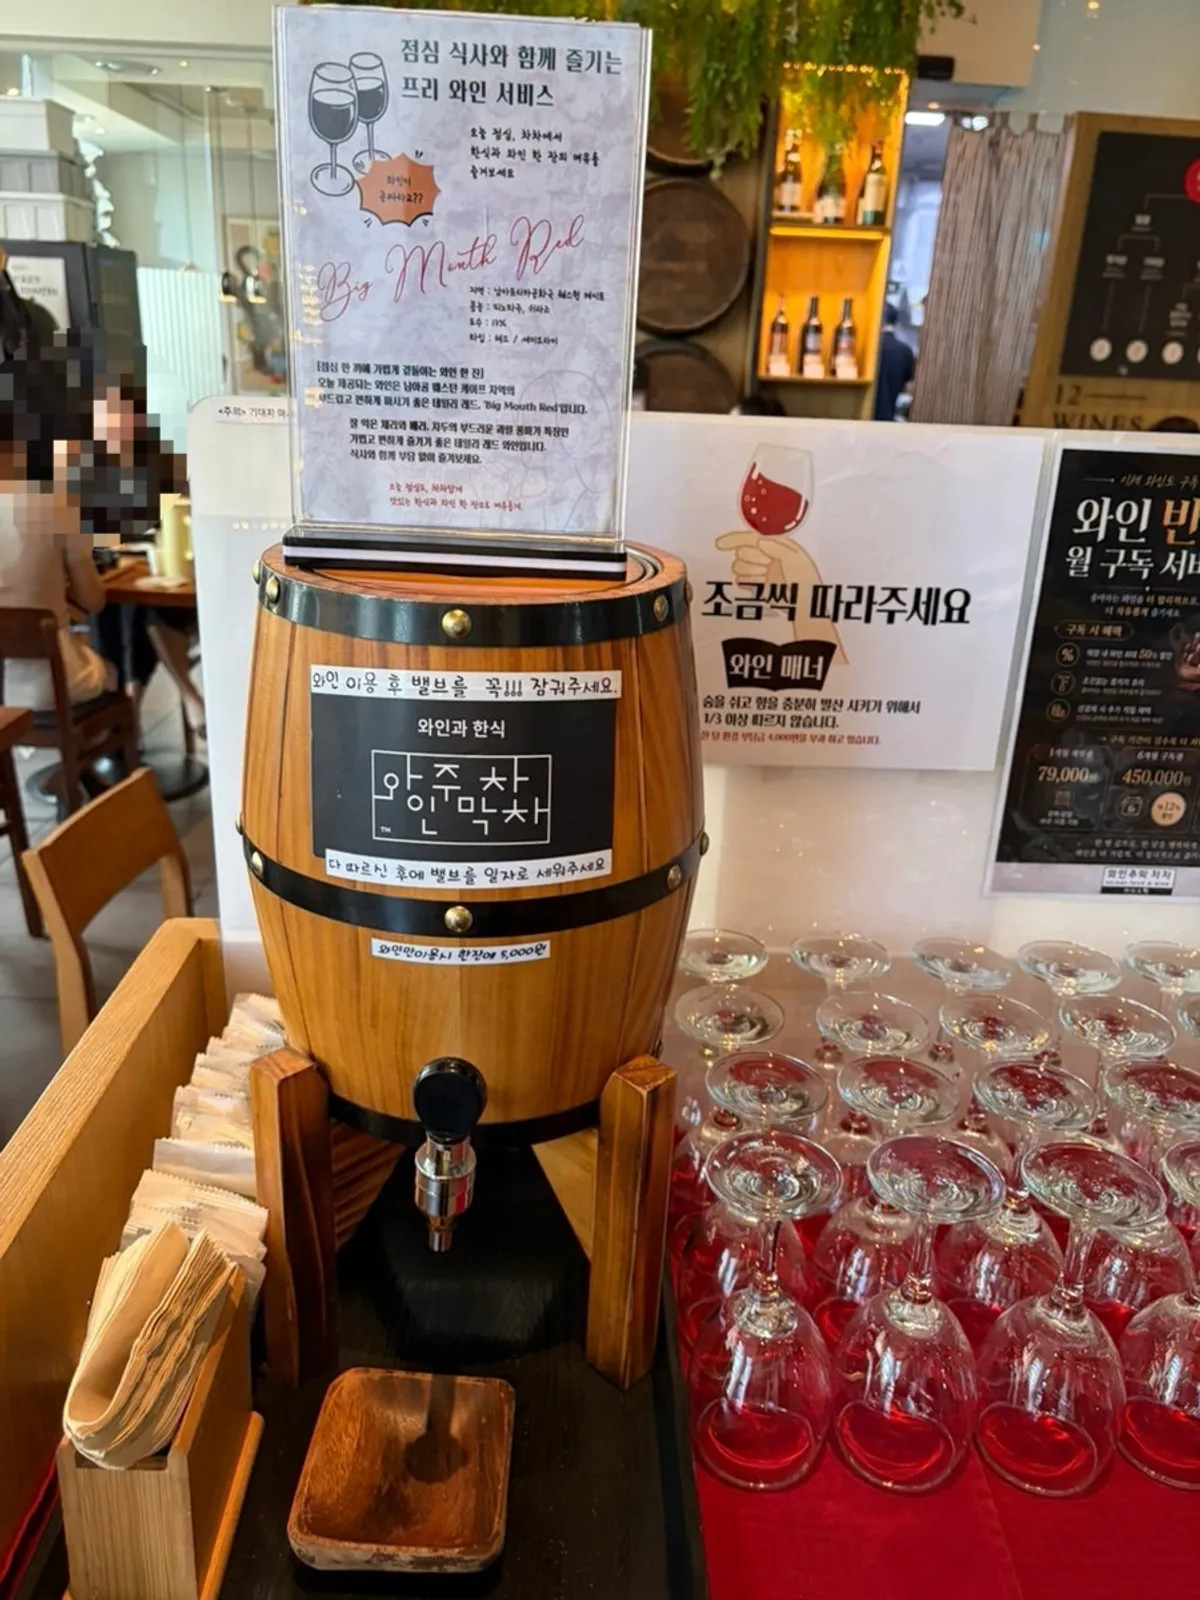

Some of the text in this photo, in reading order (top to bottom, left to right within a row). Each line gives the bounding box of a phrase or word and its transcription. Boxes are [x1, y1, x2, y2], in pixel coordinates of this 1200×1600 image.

[401, 39, 623, 75] 점심 식사와 함께 즐기는
[402, 77, 555, 107] 프리 와인 서비스
[470, 126, 487, 140] 오늘
[521, 129, 562, 143] 차차에서
[470, 144, 500, 159] 한식과
[507, 148, 526, 161] 와인
[532, 148, 541, 163] 한
[573, 151, 599, 167] 여유를
[317, 214, 585, 323] Big Mouth Red
[341, 362, 350, 374] 한
[373, 363, 400, 375] 가볍게
[439, 366, 457, 379] 와인
[459, 367, 469, 379] 한
[318, 377, 335, 388] 오늘
[337, 378, 372, 390] 제공되는
[374, 380, 401, 391] 와인은
[403, 381, 429, 393] 남아공
[461, 383, 486, 394] 케이프
[489, 385, 516, 396] 지역의
[1055, 383, 1083, 406] 12
[355, 394, 381, 406] 편하게
[384, 395, 410, 407] 마시기
[412, 397, 429, 409] 좋은
[432, 398, 458, 409] 데일리
[503, 401, 537, 412] Mouth
[360, 419, 377, 430] 익은
[380, 419, 407, 430] 체리와
[432, 421, 458, 432] 자두의
[460, 423, 493, 434] 부드러운
[496, 424, 513, 436] 과일
[516, 425, 542, 437] 풍미가
[349, 433, 375, 444] 가볍고
[377, 435, 404, 446] 편하게
[406, 436, 432, 447] 즐기기
[435, 437, 451, 448] 좋은
[454, 438, 480, 449] 데일리
[482, 439, 500, 450] 레드
[349, 449, 376, 460] 식사와
[378, 450, 396, 460] 함께
[399, 451, 415, 461] 부담
[418, 451, 436, 462] 없이
[1072, 496, 1153, 543] 와인
[1065, 546, 1093, 578] 월
[1100, 548, 1154, 580] 구독
[701, 581, 972, 626] 조금씩 따라주세요
[729, 652, 824, 681] 와인 매너
[313, 670, 339, 690] 와인
[346, 671, 378, 694] 이용
[387, 673, 403, 696] 후
[411, 674, 468, 698] 밸브를
[530, 677, 618, 695] 잠궈주세요.
[703, 694, 921, 714] 숨을 쉬고 향을 충분히 발산 시키기 위해서
[417, 719, 506, 739] 와인과 한식
[704, 713, 839, 729] 1/3 이상 따르지 않습니다.
[328, 857, 605, 885] 다 따르신 후에 밸브를 일자로 세워주세요
[458, 948, 496, 962] 한잔에
[500, 942, 547, 960] 5,000원
